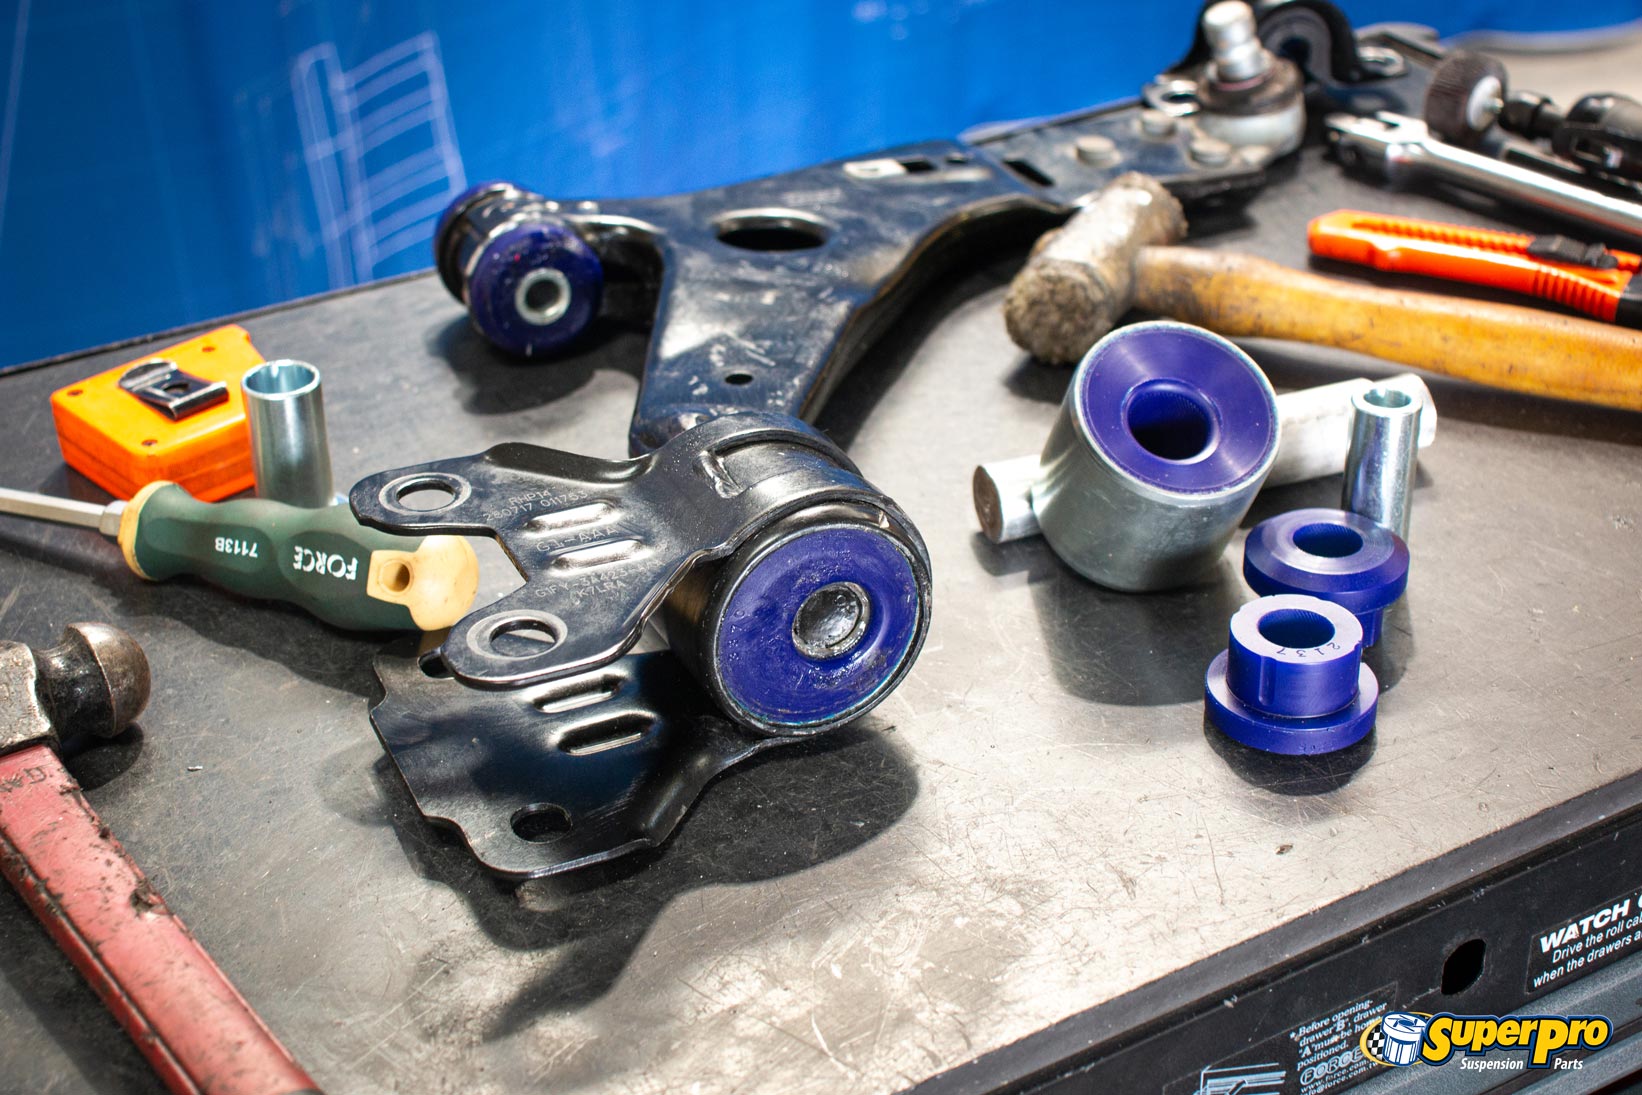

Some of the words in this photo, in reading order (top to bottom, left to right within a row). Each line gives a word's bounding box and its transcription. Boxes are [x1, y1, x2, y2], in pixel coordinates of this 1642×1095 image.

[540, 490, 588, 508] 011753
[214, 536, 259, 559] 7113B
[292, 545, 359, 581] FORCE
[1540, 898, 1631, 953] WATCH
[1552, 940, 1583, 963] Drive
[1585, 932, 1603, 948] the
[1605, 919, 1625, 939] roll
[1533, 964, 1564, 988] when
[1566, 956, 1585, 974] the
[1586, 932, 1632, 964] drawers
[1298, 1017, 1331, 1037] Before
[1353, 1002, 1388, 1023] drawer
[1340, 1026, 1353, 1040] be
[1296, 1040, 1349, 1071] positioned.
[1300, 1045, 1364, 1086] FORCE
[1300, 1059, 1374, 1094] www.force.com.
